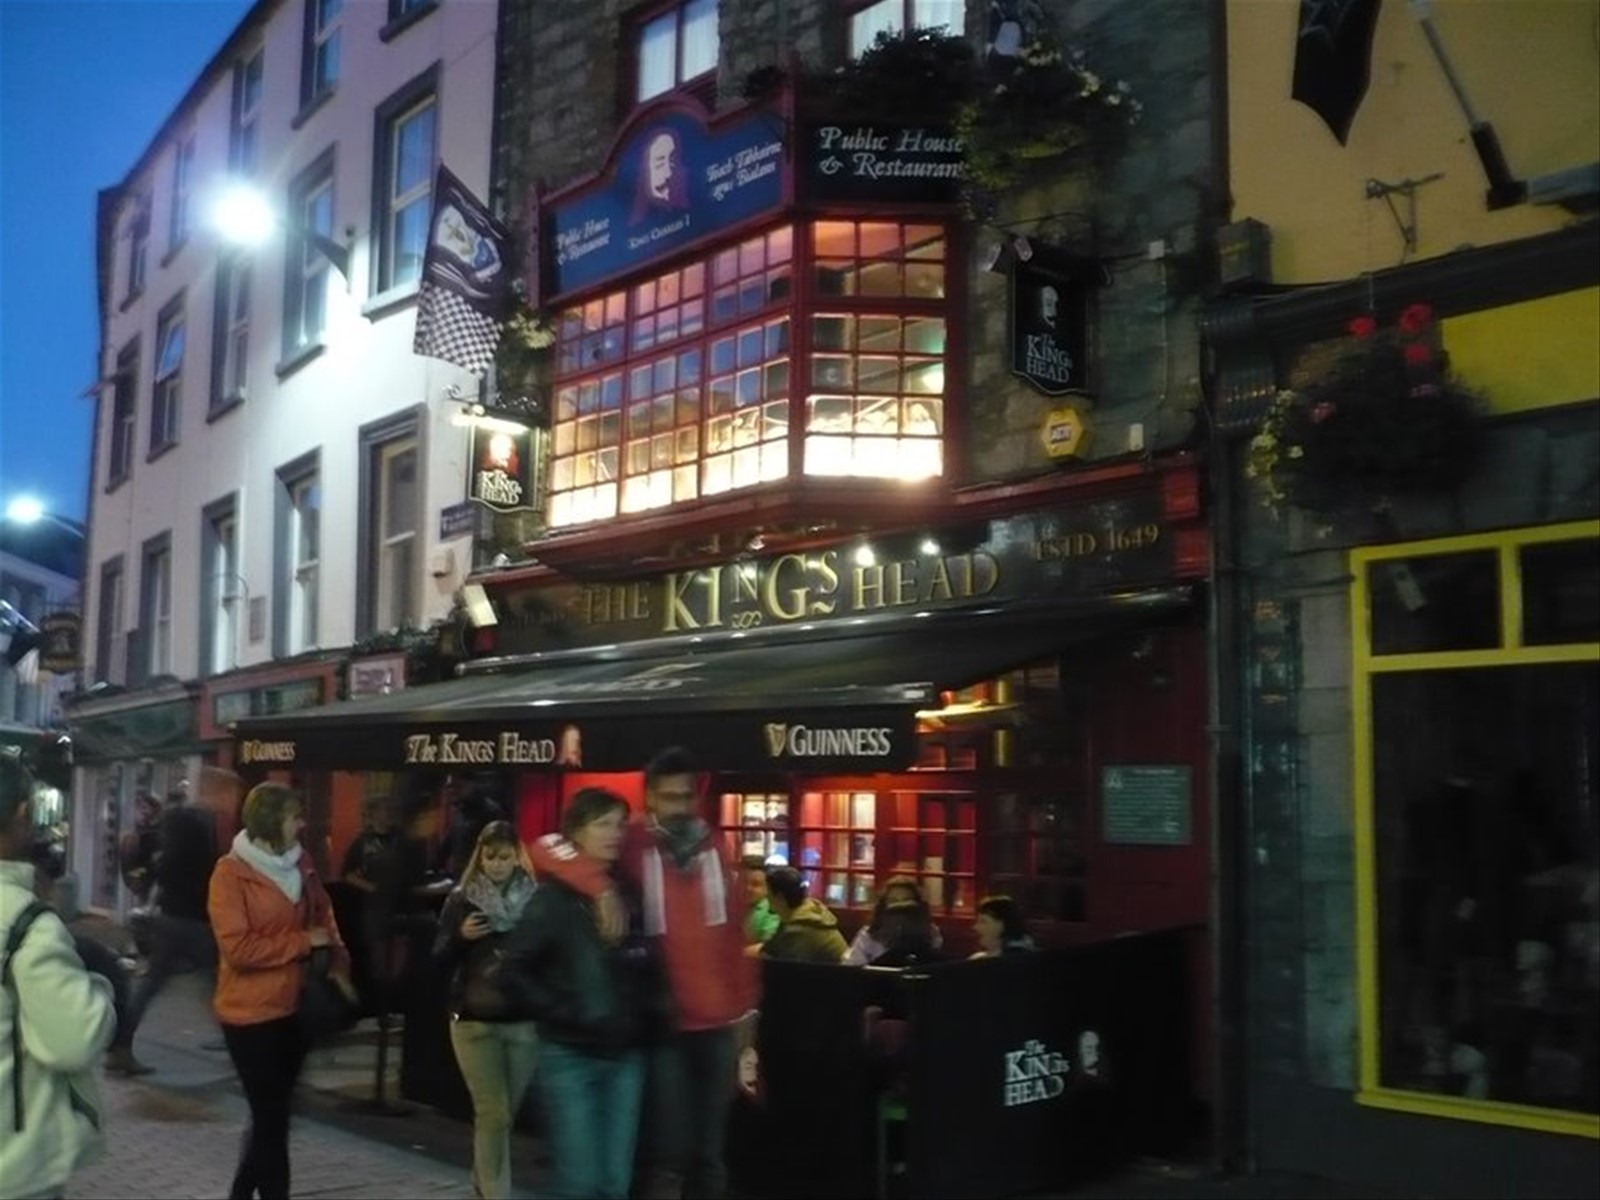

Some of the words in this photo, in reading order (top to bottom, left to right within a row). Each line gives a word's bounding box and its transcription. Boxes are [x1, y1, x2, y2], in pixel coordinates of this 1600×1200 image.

[820, 127, 888, 149] Public
[896, 130, 963, 152] House
[819, 156, 843, 175] &
[581, 581, 650, 624] THE
[661, 550, 840, 632] KINGS
[852, 551, 999, 612] HEAD
[405, 733, 438, 764] The
[438, 732, 496, 764] KINGS
[499, 731, 556, 764] HEAD
[789, 724, 894, 757] GUINNESS
[1004, 1074, 1065, 1107] HEAD
